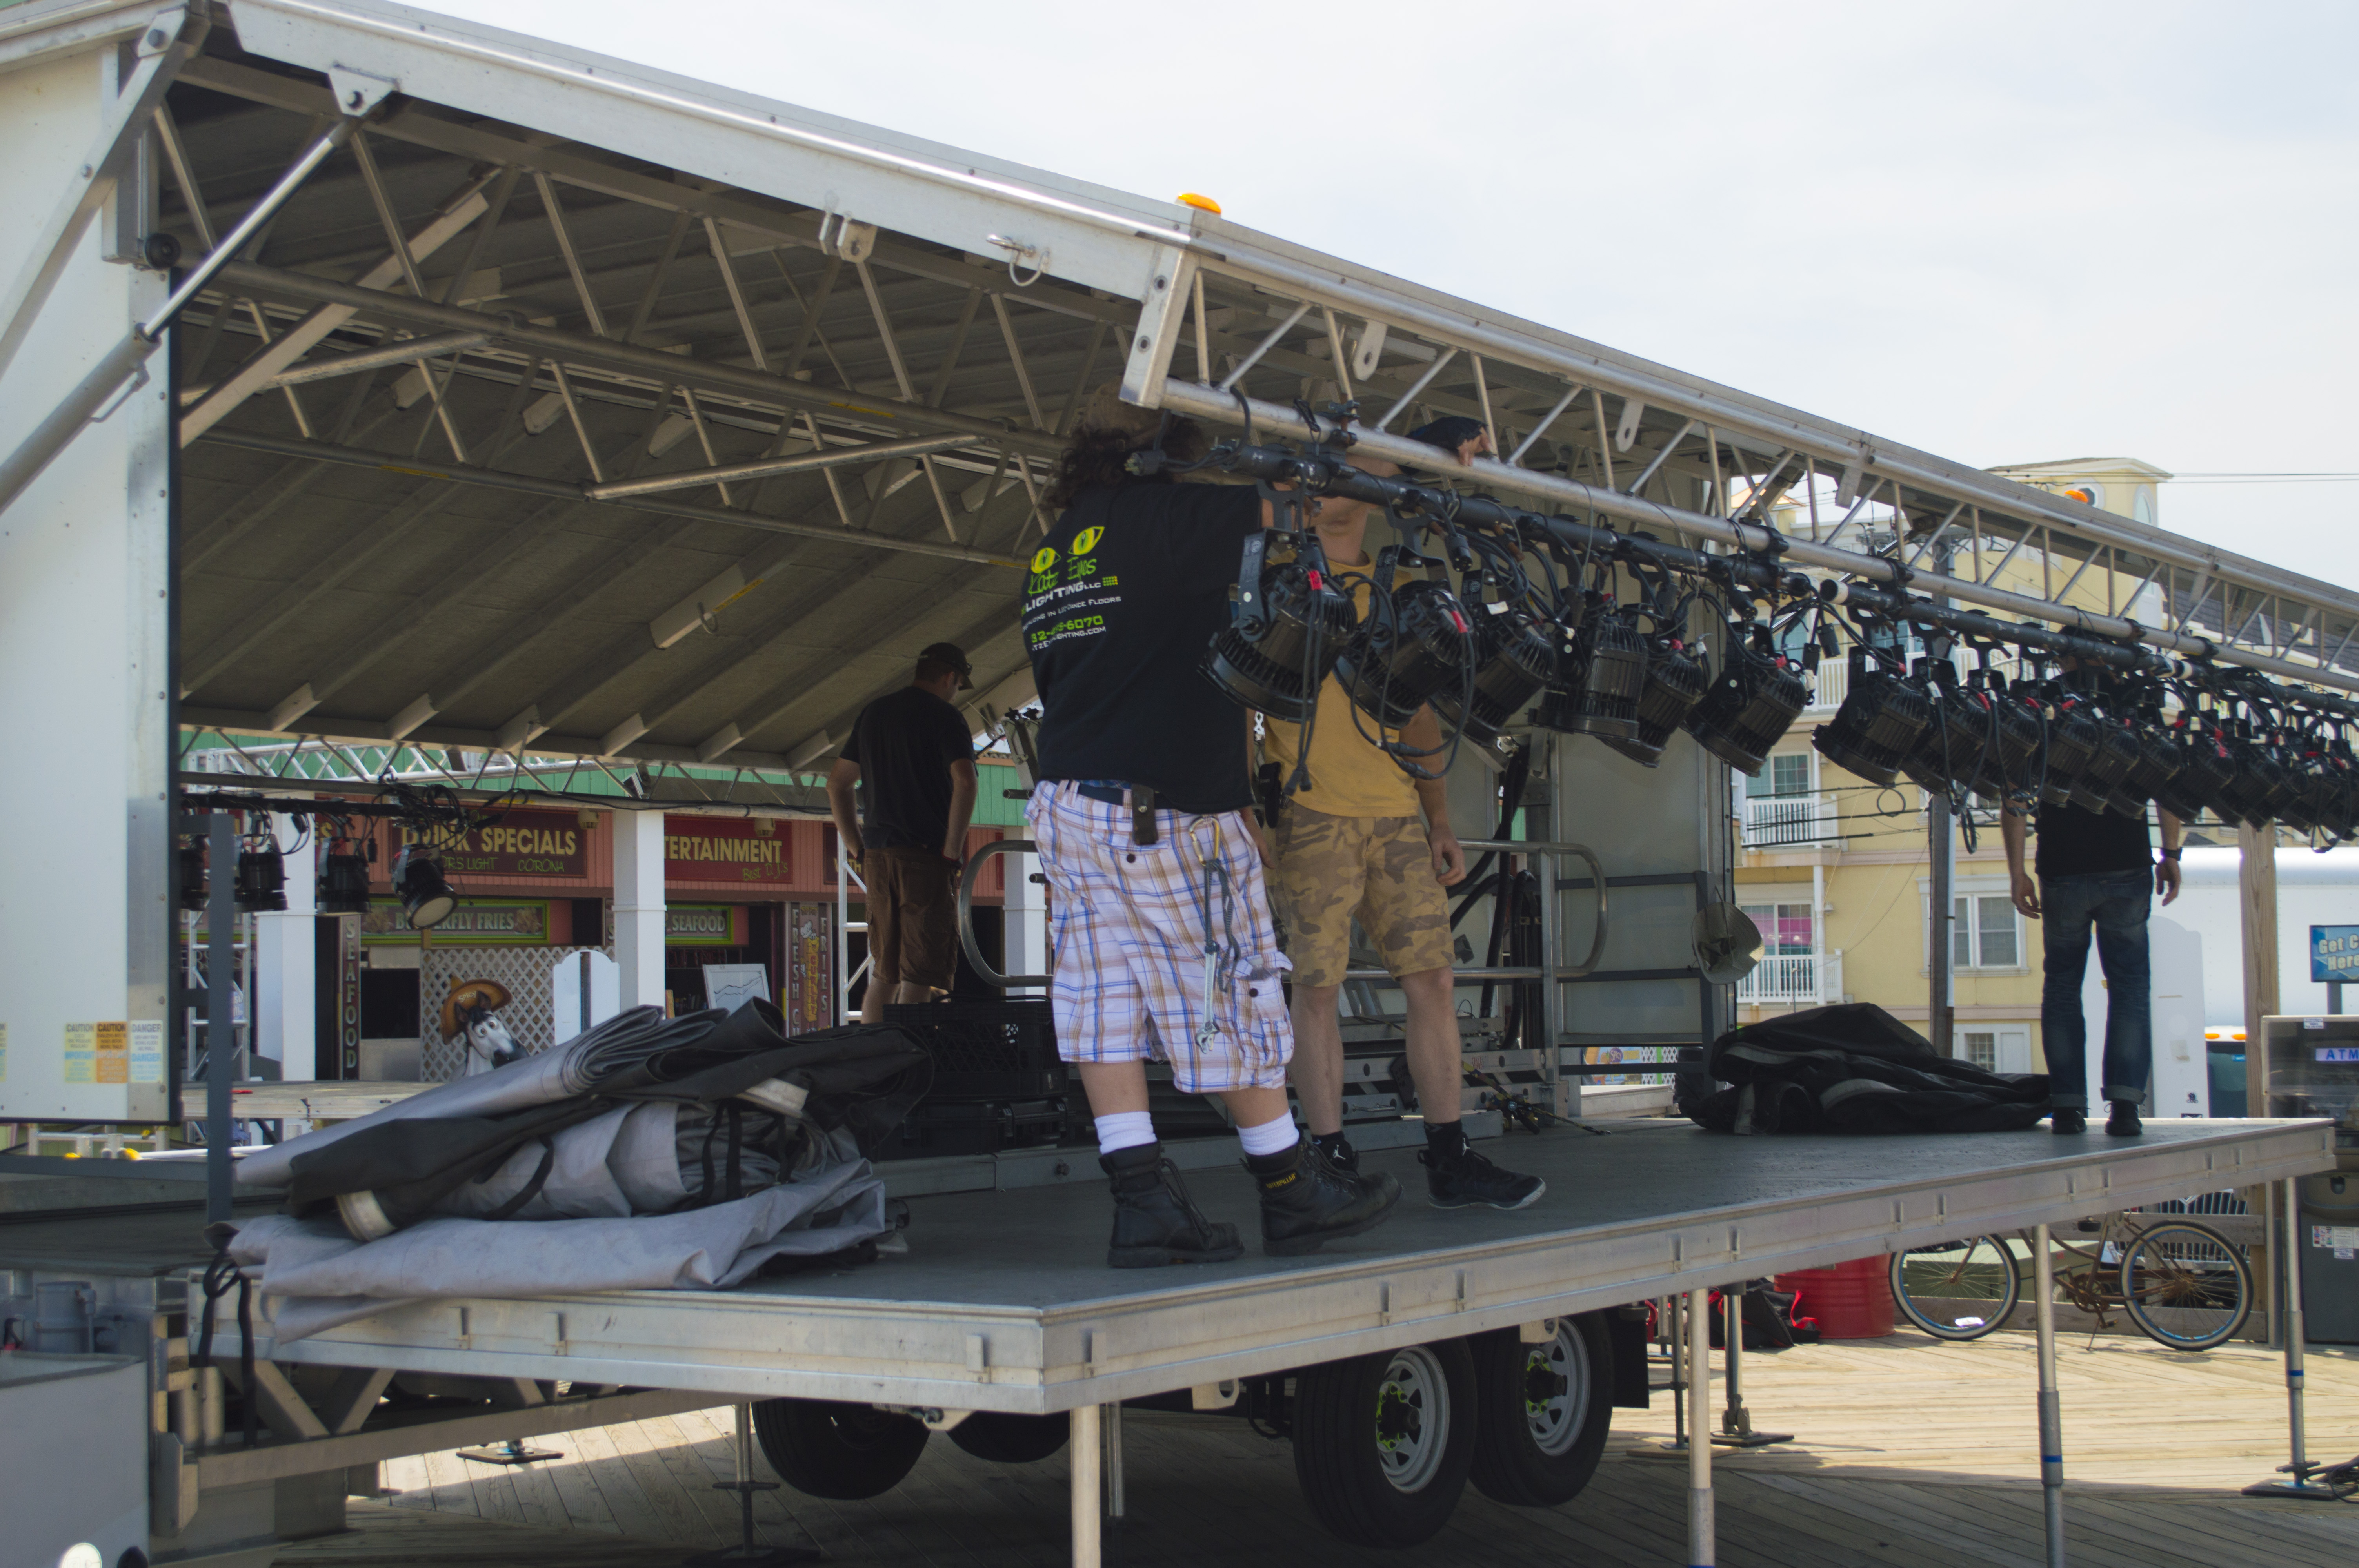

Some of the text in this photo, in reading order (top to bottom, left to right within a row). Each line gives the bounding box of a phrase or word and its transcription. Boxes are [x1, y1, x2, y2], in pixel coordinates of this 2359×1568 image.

[1088, 596, 1121, 606] FLOORS
[481, 827, 576, 855] SPECIALS
[467, 857, 499, 870] LIGHT
[518, 858, 565, 872] CORONA
[742, 867, 762, 881] Best
[477, 912, 515, 930] FRIES
[672, 915, 726, 932] SEAFOOD
[2319, 938, 2344, 954] Get
[2327, 954, 2359, 971] Here
[345, 920, 358, 1069] SEAFOOD
[67, 1023, 95, 1032] CAUTION
[98, 1023, 127, 1032] CAUTION
[132, 1024, 162, 1033] DANGER
[2326, 1049, 2359, 1060] ATM
[1266, 1172, 1296, 1189] CATERPILLAR
